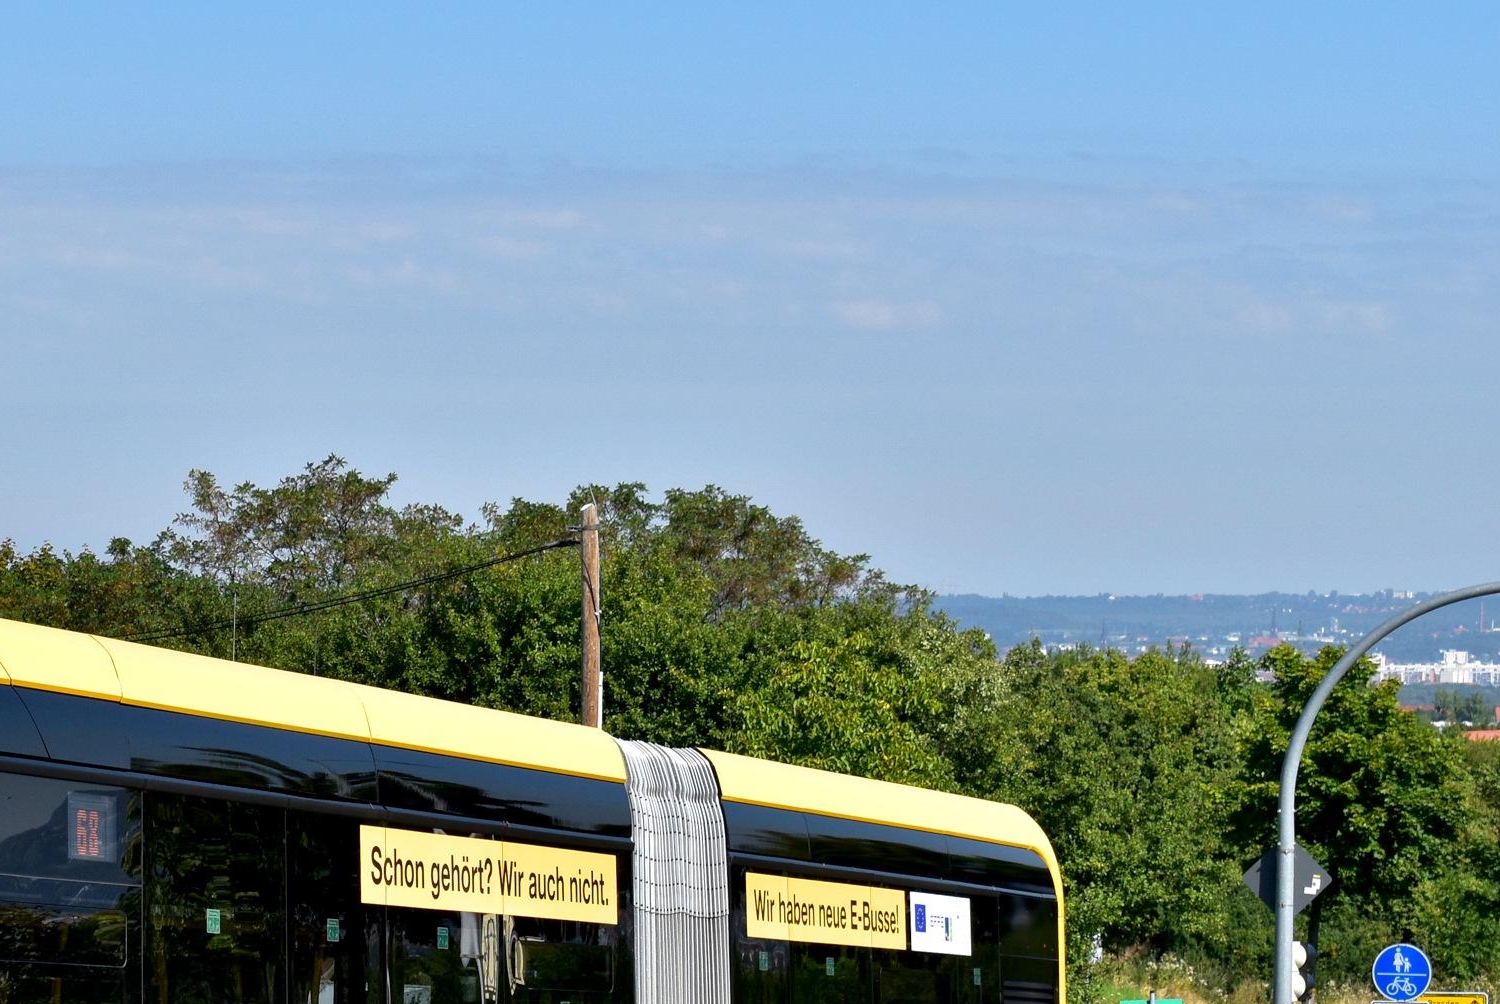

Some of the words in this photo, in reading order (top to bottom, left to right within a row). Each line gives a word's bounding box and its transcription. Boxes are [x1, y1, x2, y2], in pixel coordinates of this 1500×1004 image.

[76, 809, 99, 856] 68
[371, 845, 424, 888] Schon
[431, 855, 493, 899] gehört?
[497, 859, 524, 897] Wir
[528, 866, 565, 902] auch
[569, 869, 609, 906] nicht.
[753, 889, 775, 921] Wir
[778, 891, 816, 927] haben
[818, 904, 847, 929] neue
[850, 899, 900, 934] E-Busse!
